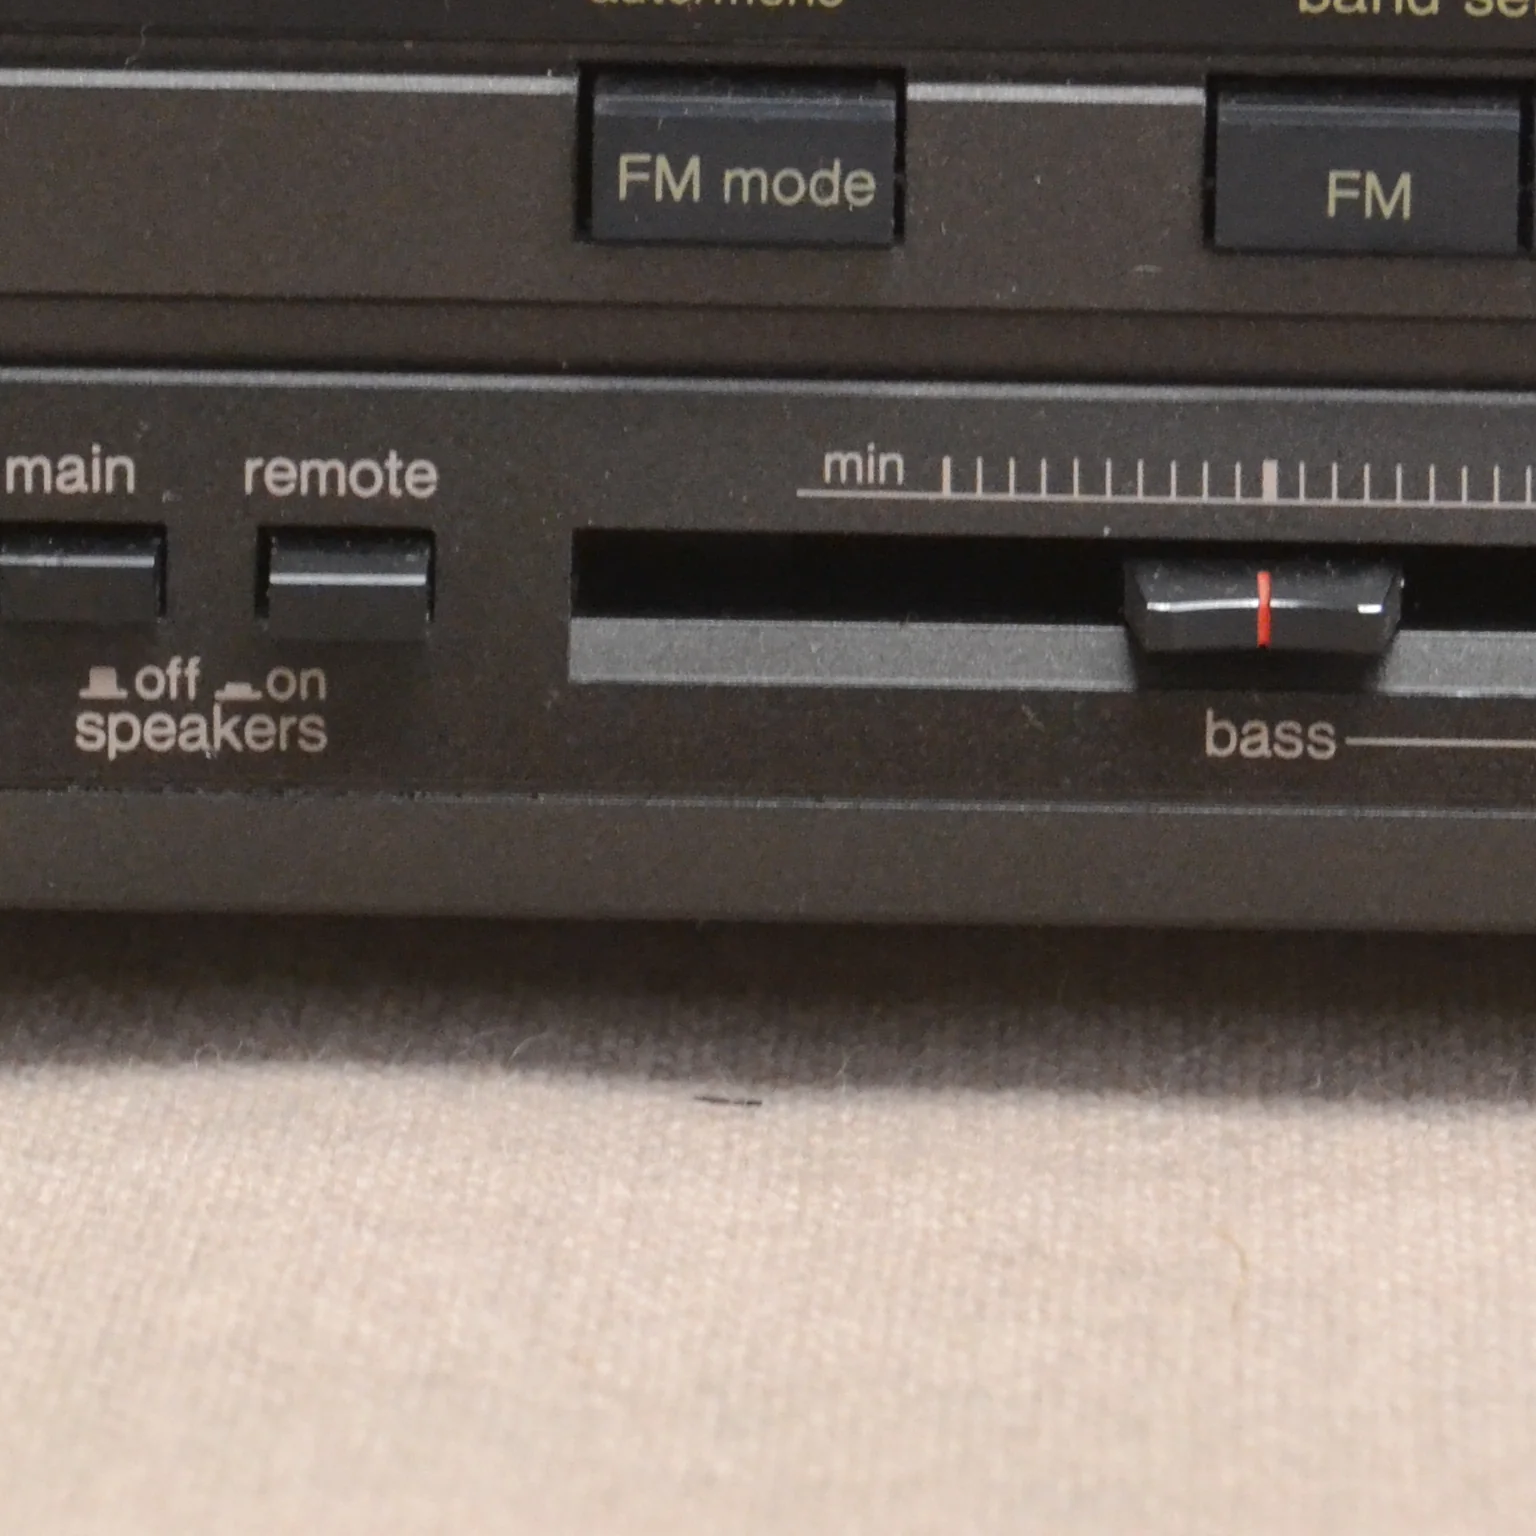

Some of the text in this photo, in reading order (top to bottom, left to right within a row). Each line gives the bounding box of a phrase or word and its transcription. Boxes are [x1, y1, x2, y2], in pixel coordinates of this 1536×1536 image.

[617, 154, 877, 207] FM mode
[1326, 170, 1413, 220] FM
[4, 446, 136, 495] main
[244, 449, 439, 498] remote
[822, 444, 905, 485] min
[135, 657, 327, 700] off on
[75, 706, 329, 761] speakers
[1204, 710, 1338, 758] bass
